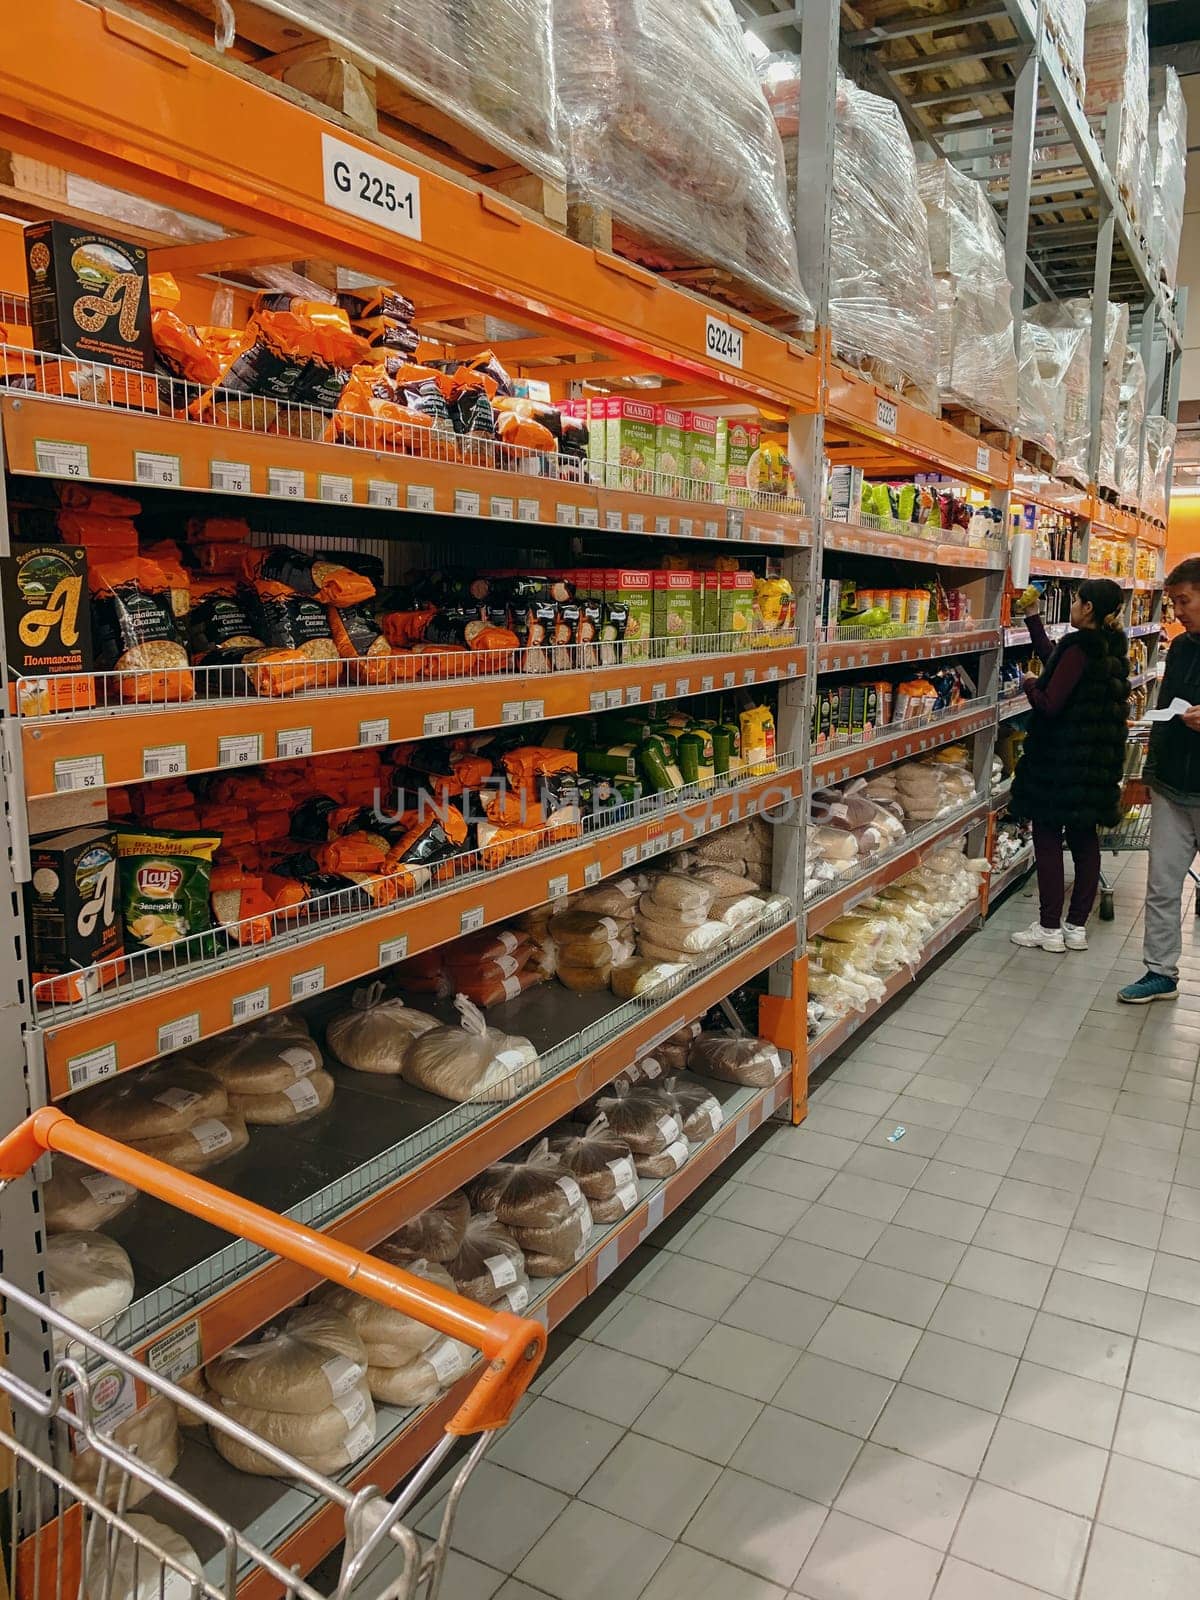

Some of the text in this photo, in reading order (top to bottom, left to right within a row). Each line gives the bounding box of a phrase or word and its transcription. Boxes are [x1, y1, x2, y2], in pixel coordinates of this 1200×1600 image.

[334, 161, 413, 219] G 225-1
[707, 323, 741, 361] G224-1
[68, 465, 80, 475] 52
[162, 472, 173, 482] 63
[232, 480, 242, 490] 76
[24, 655, 82, 666] Полтавская
[84, 776, 95, 786] 52
[252, 1000, 265, 1010] 112
